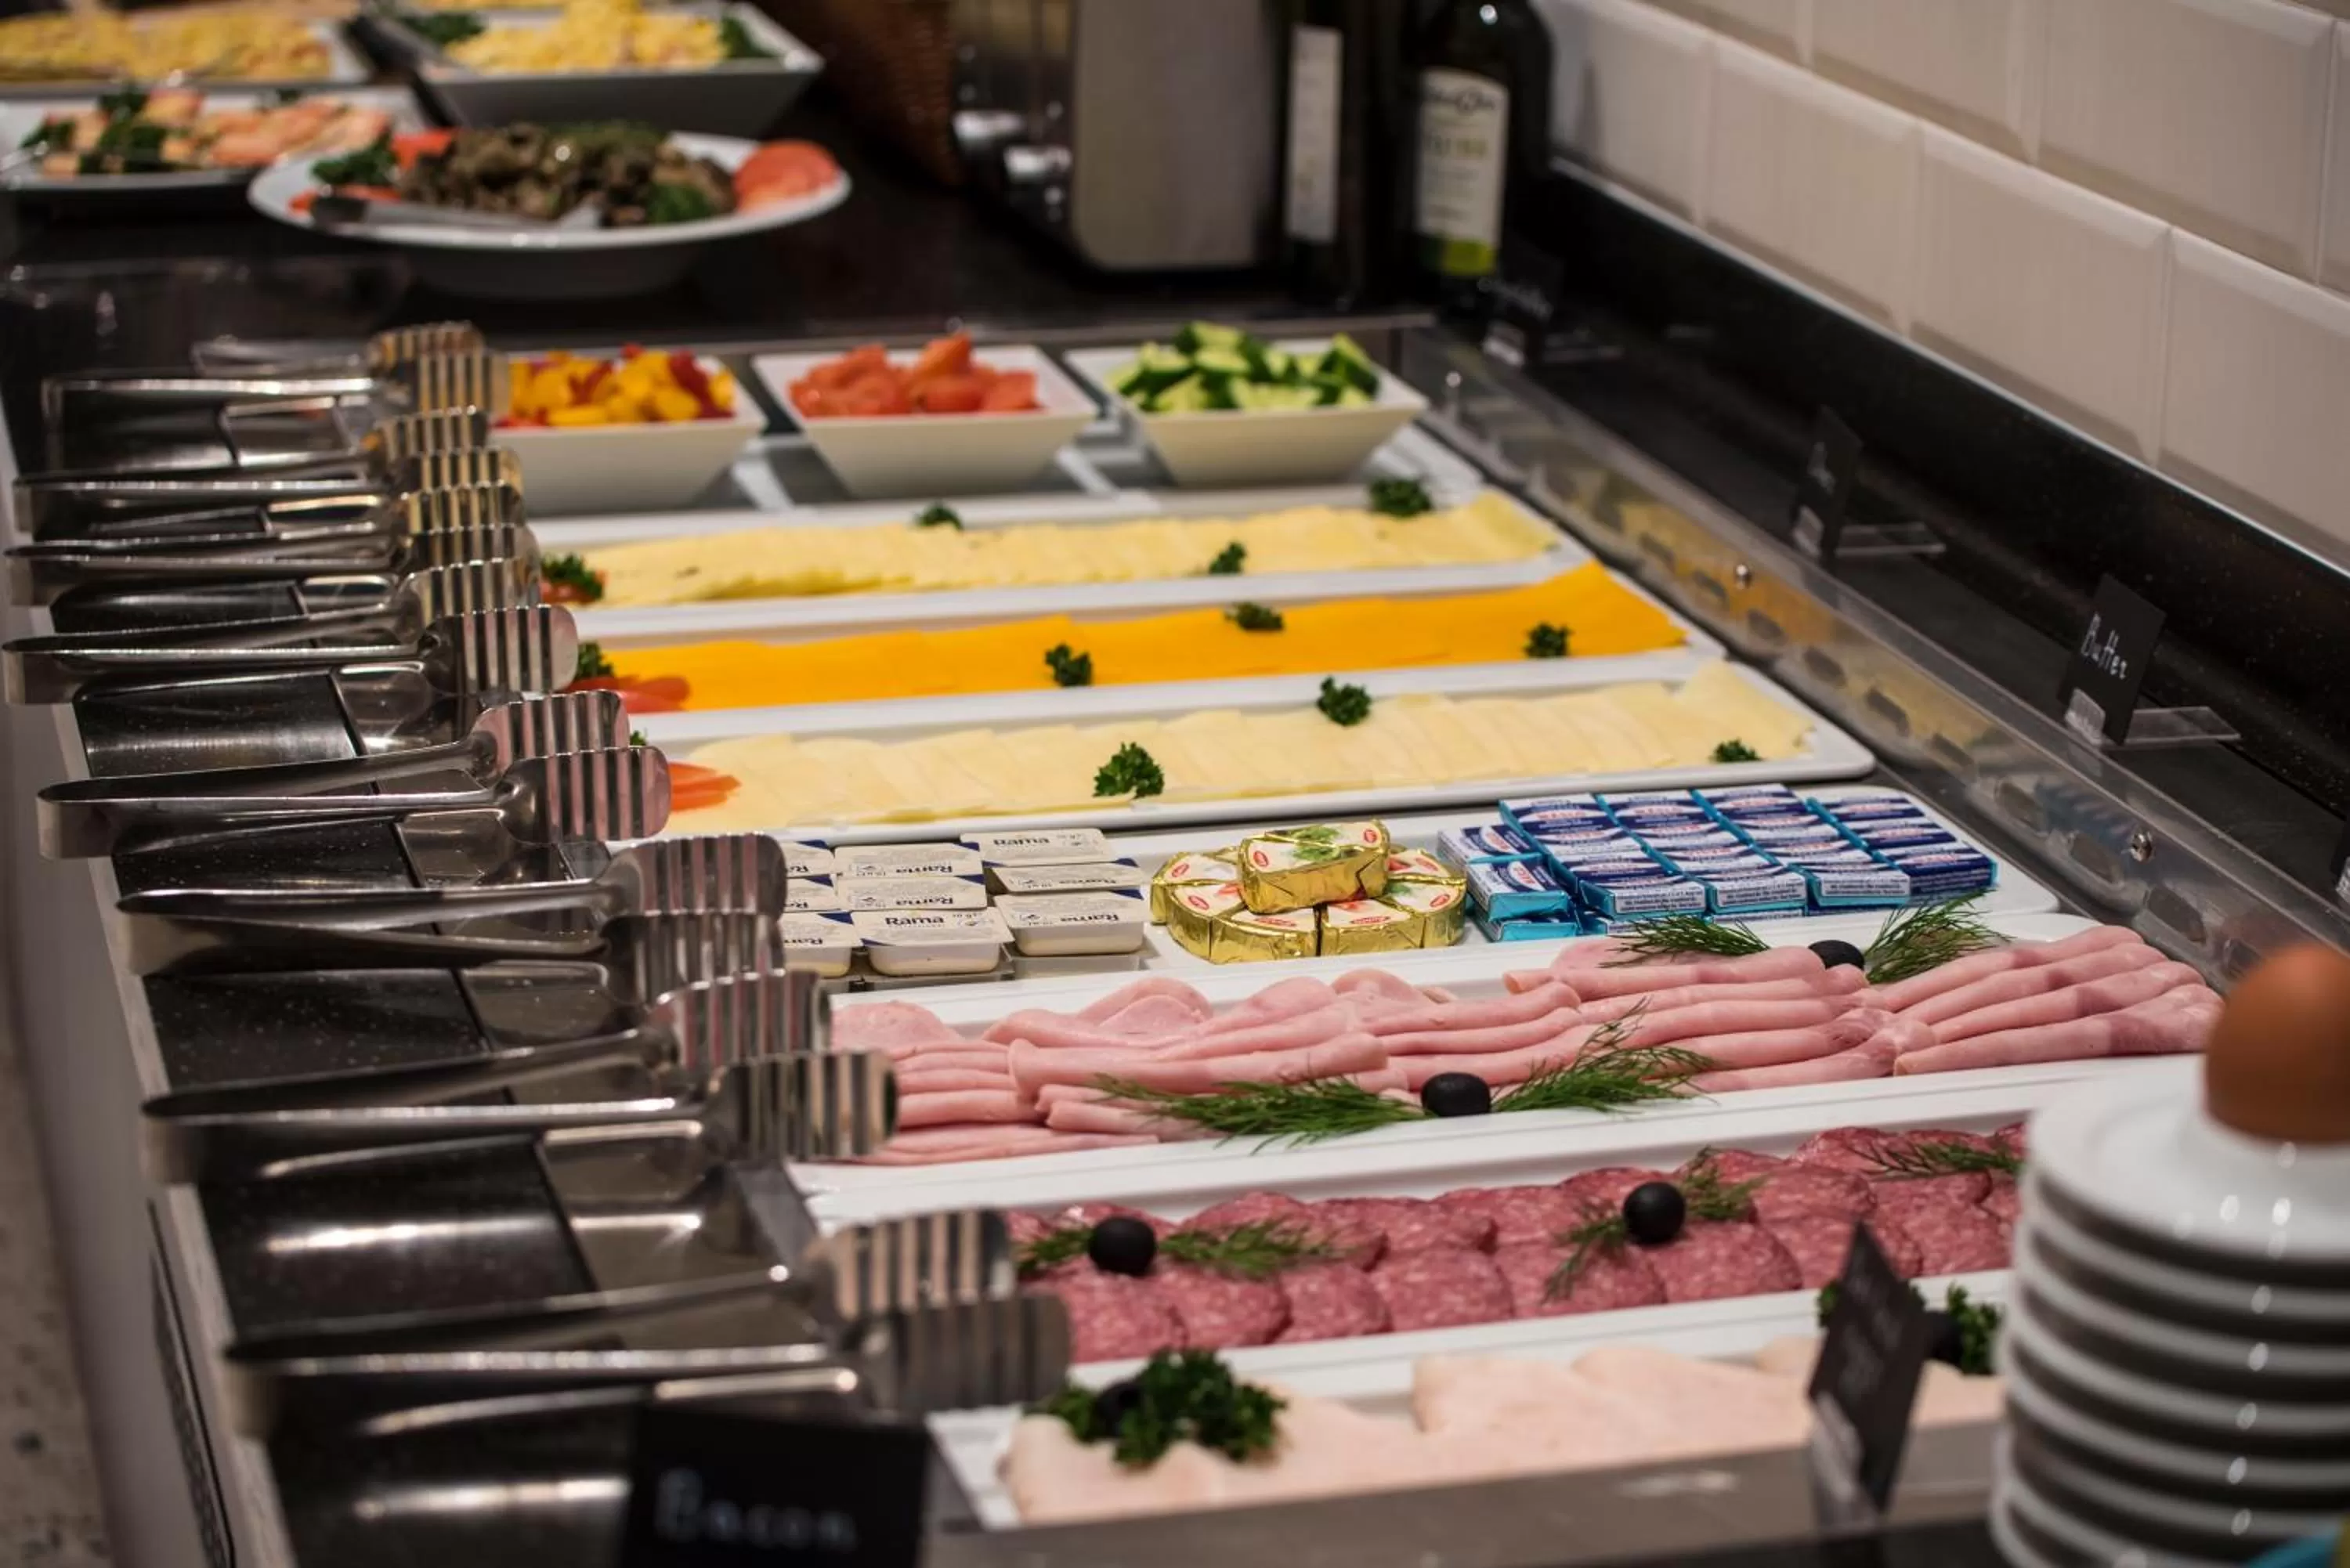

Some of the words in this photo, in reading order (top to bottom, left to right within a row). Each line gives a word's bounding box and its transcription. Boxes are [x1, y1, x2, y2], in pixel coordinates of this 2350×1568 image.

[895, 865, 953, 873] Rama
[895, 897, 954, 906] Rama
[884, 915, 945, 926] Rama
